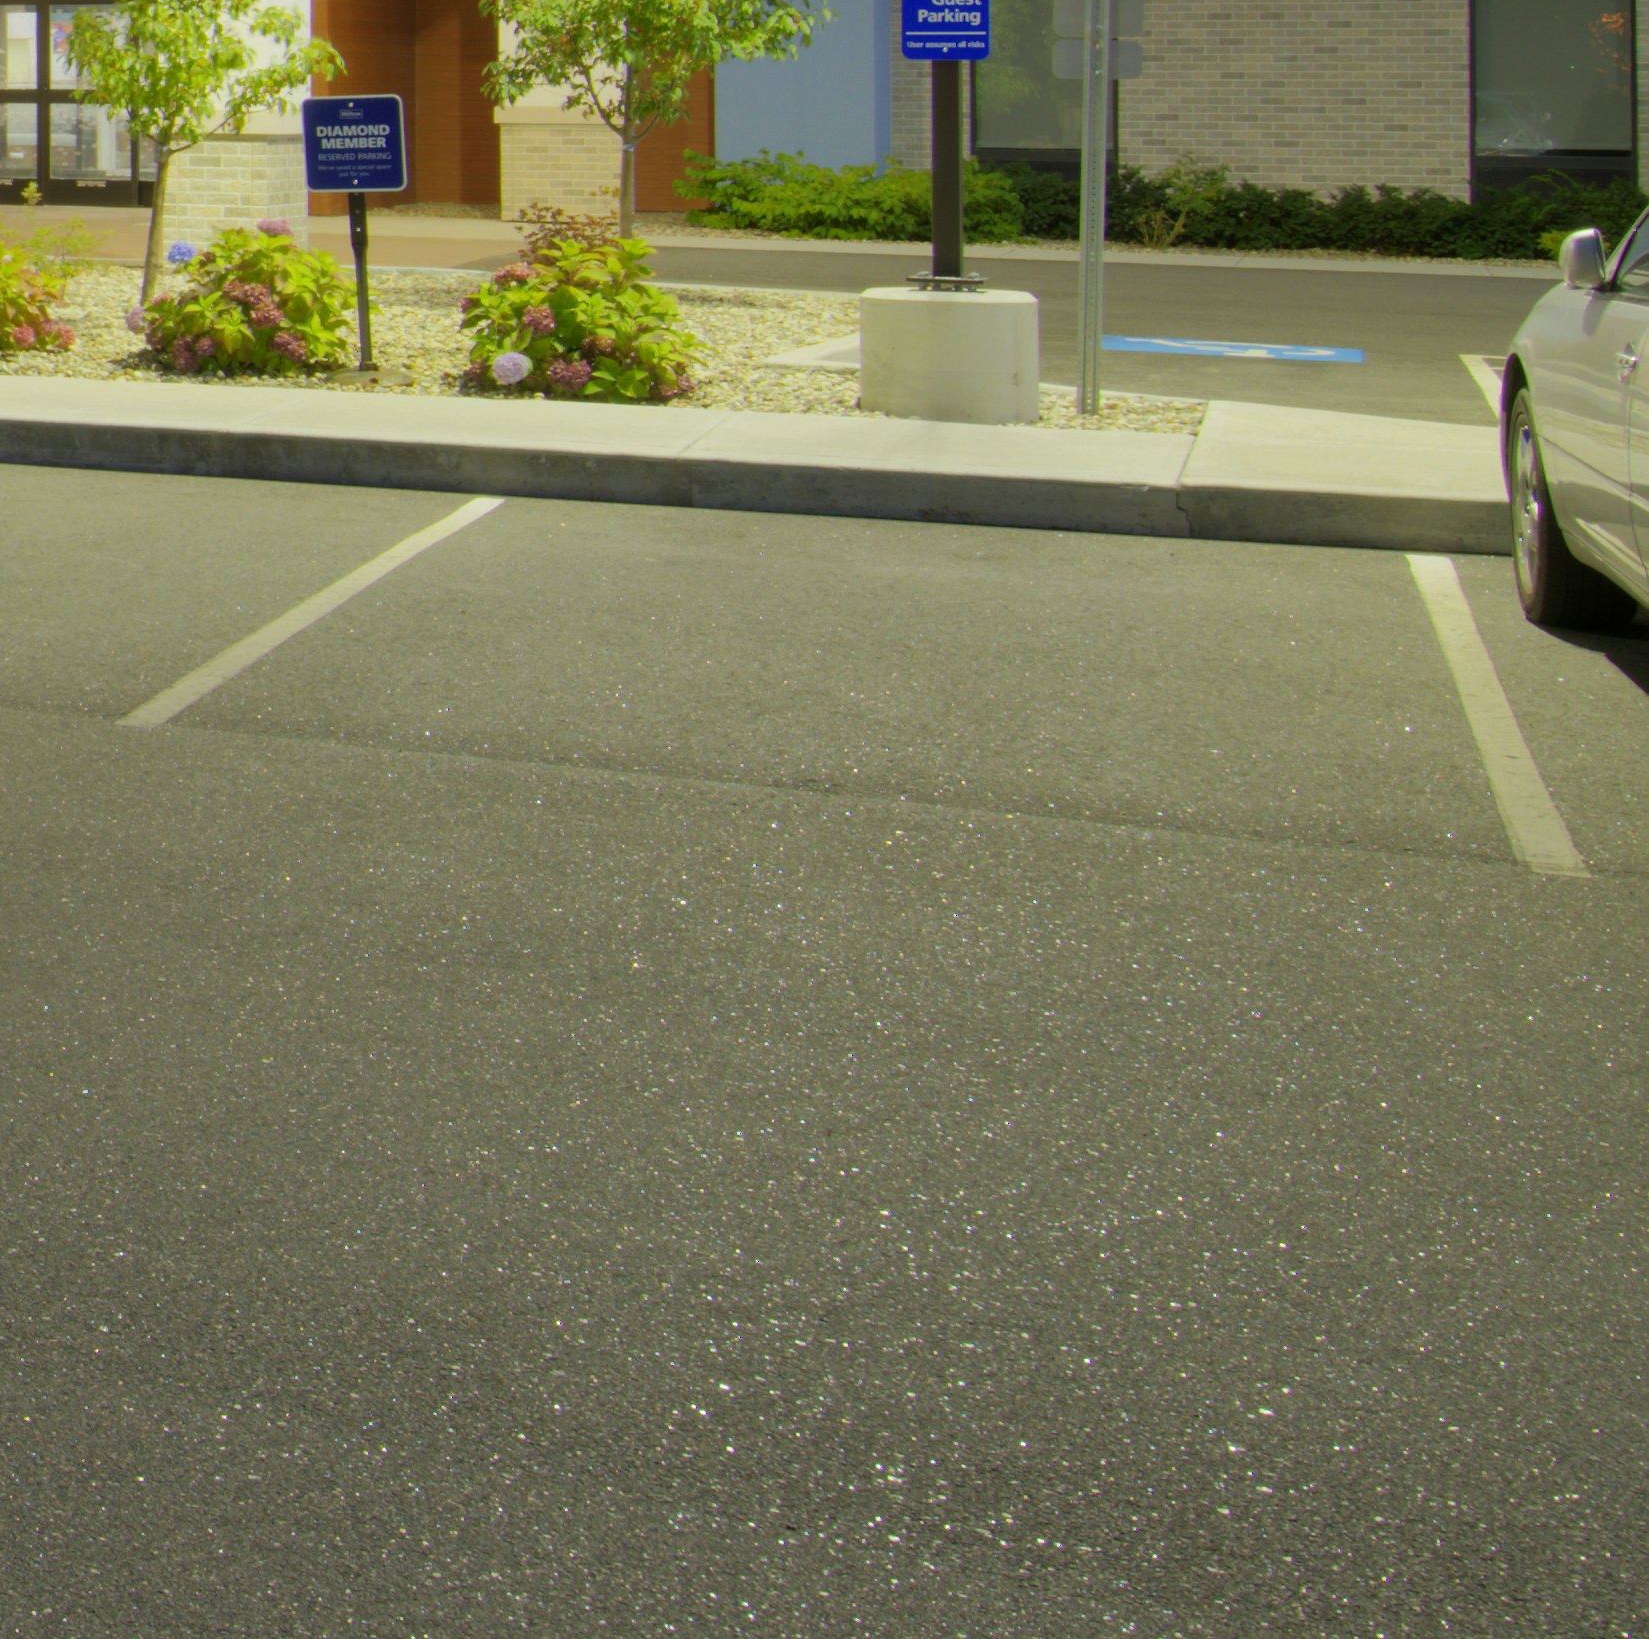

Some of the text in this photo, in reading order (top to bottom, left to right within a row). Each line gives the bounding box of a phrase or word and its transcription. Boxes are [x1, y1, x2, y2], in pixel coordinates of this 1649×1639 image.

[917, 8, 981, 26] Parking
[316, 124, 390, 137] DIAMOND
[321, 137, 387, 149] MEMBER
[318, 152, 392, 161] RESERVED PARKING
